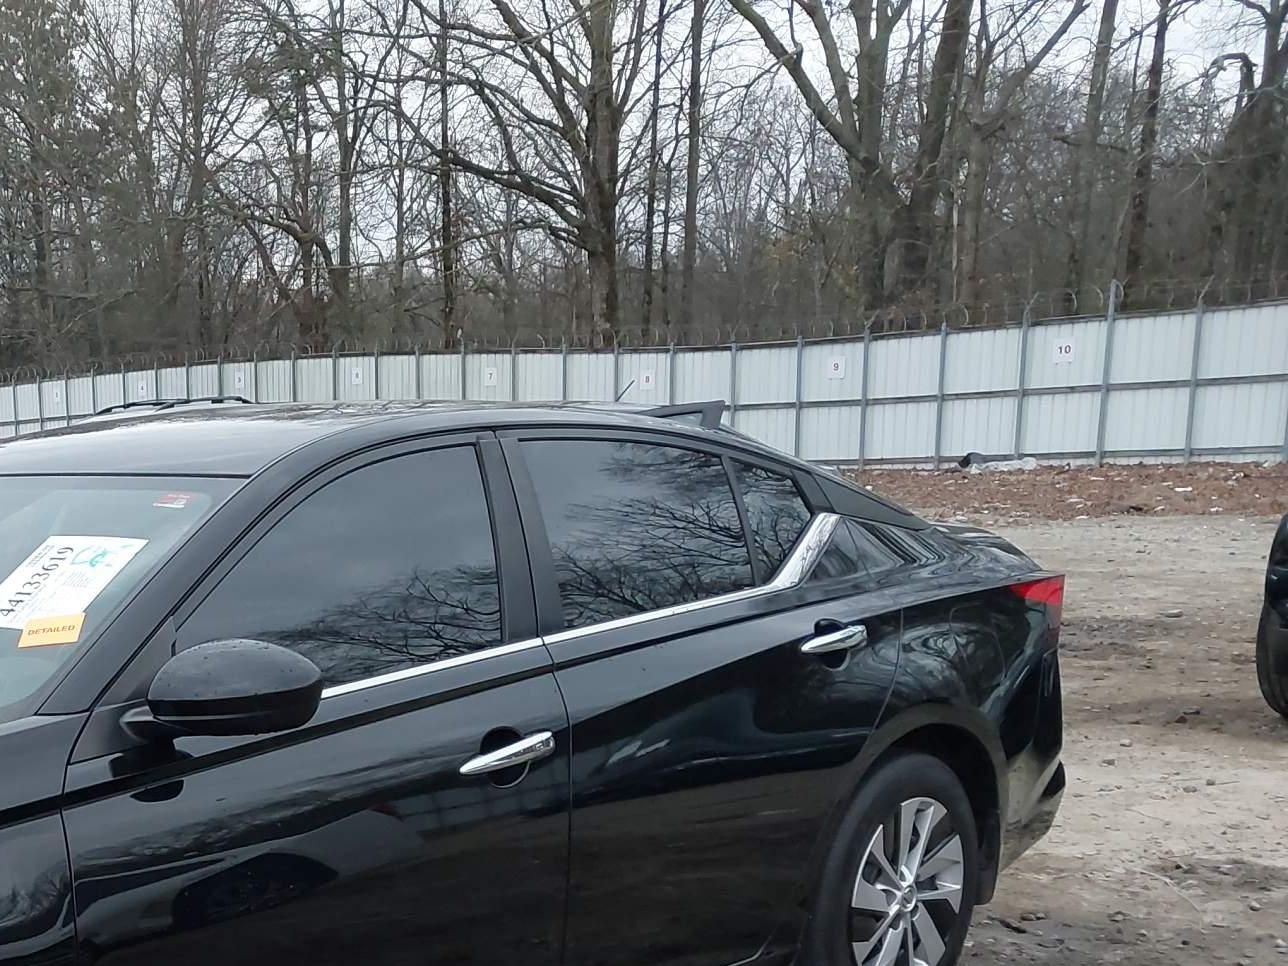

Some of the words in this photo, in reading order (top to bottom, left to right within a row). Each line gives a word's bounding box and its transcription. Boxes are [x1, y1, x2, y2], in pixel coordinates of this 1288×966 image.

[1057, 344, 1072, 354] 10
[833, 362, 840, 371] 9
[0, 546, 74, 617] 44133619
[27, 625, 76, 637] DETAILED
